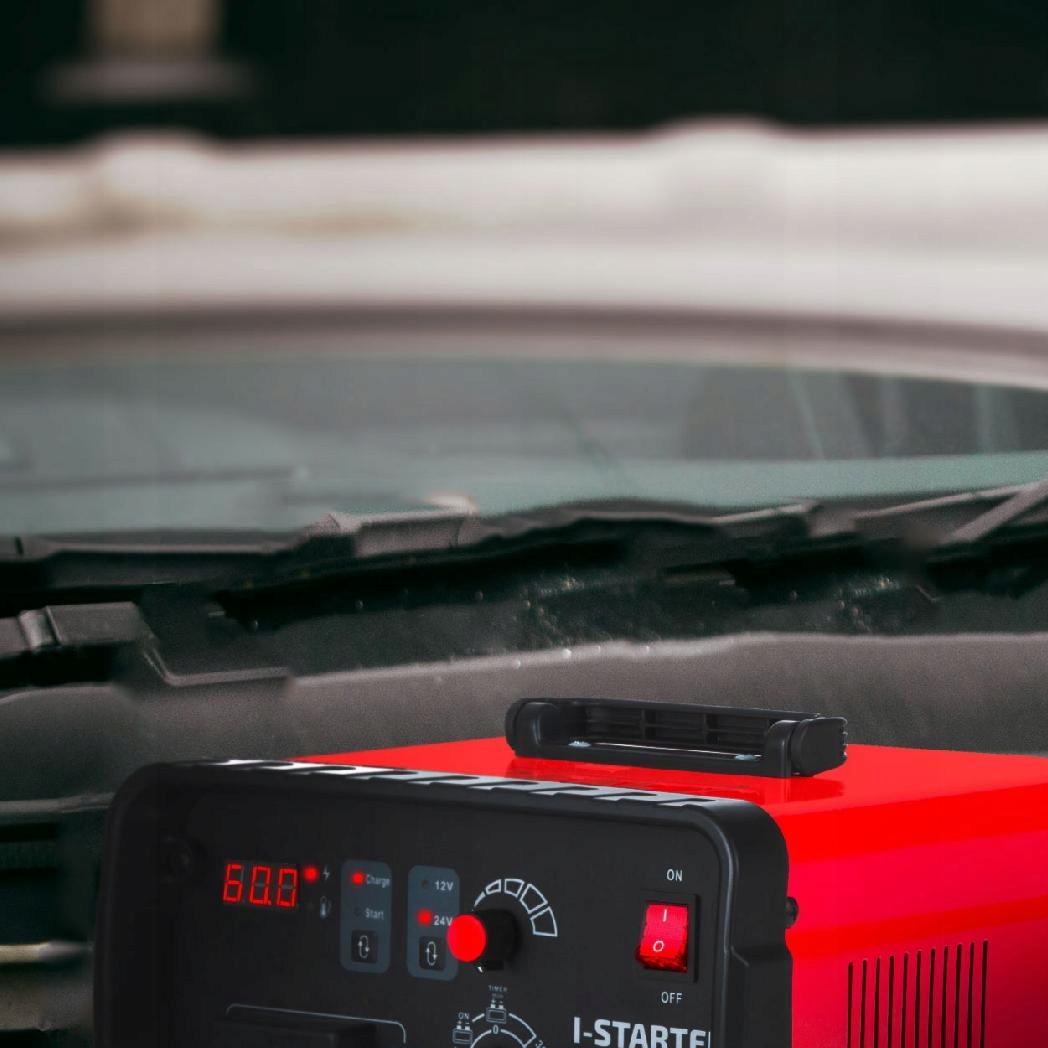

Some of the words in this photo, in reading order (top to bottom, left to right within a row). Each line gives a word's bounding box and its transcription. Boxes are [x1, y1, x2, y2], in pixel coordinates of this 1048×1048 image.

[666, 868, 683, 882] ON
[434, 880, 454, 891] 12V
[365, 908, 384, 920] Start
[433, 915, 453, 926] 24V
[661, 992, 683, 1004] OFF
[458, 1012, 470, 1020] ON
